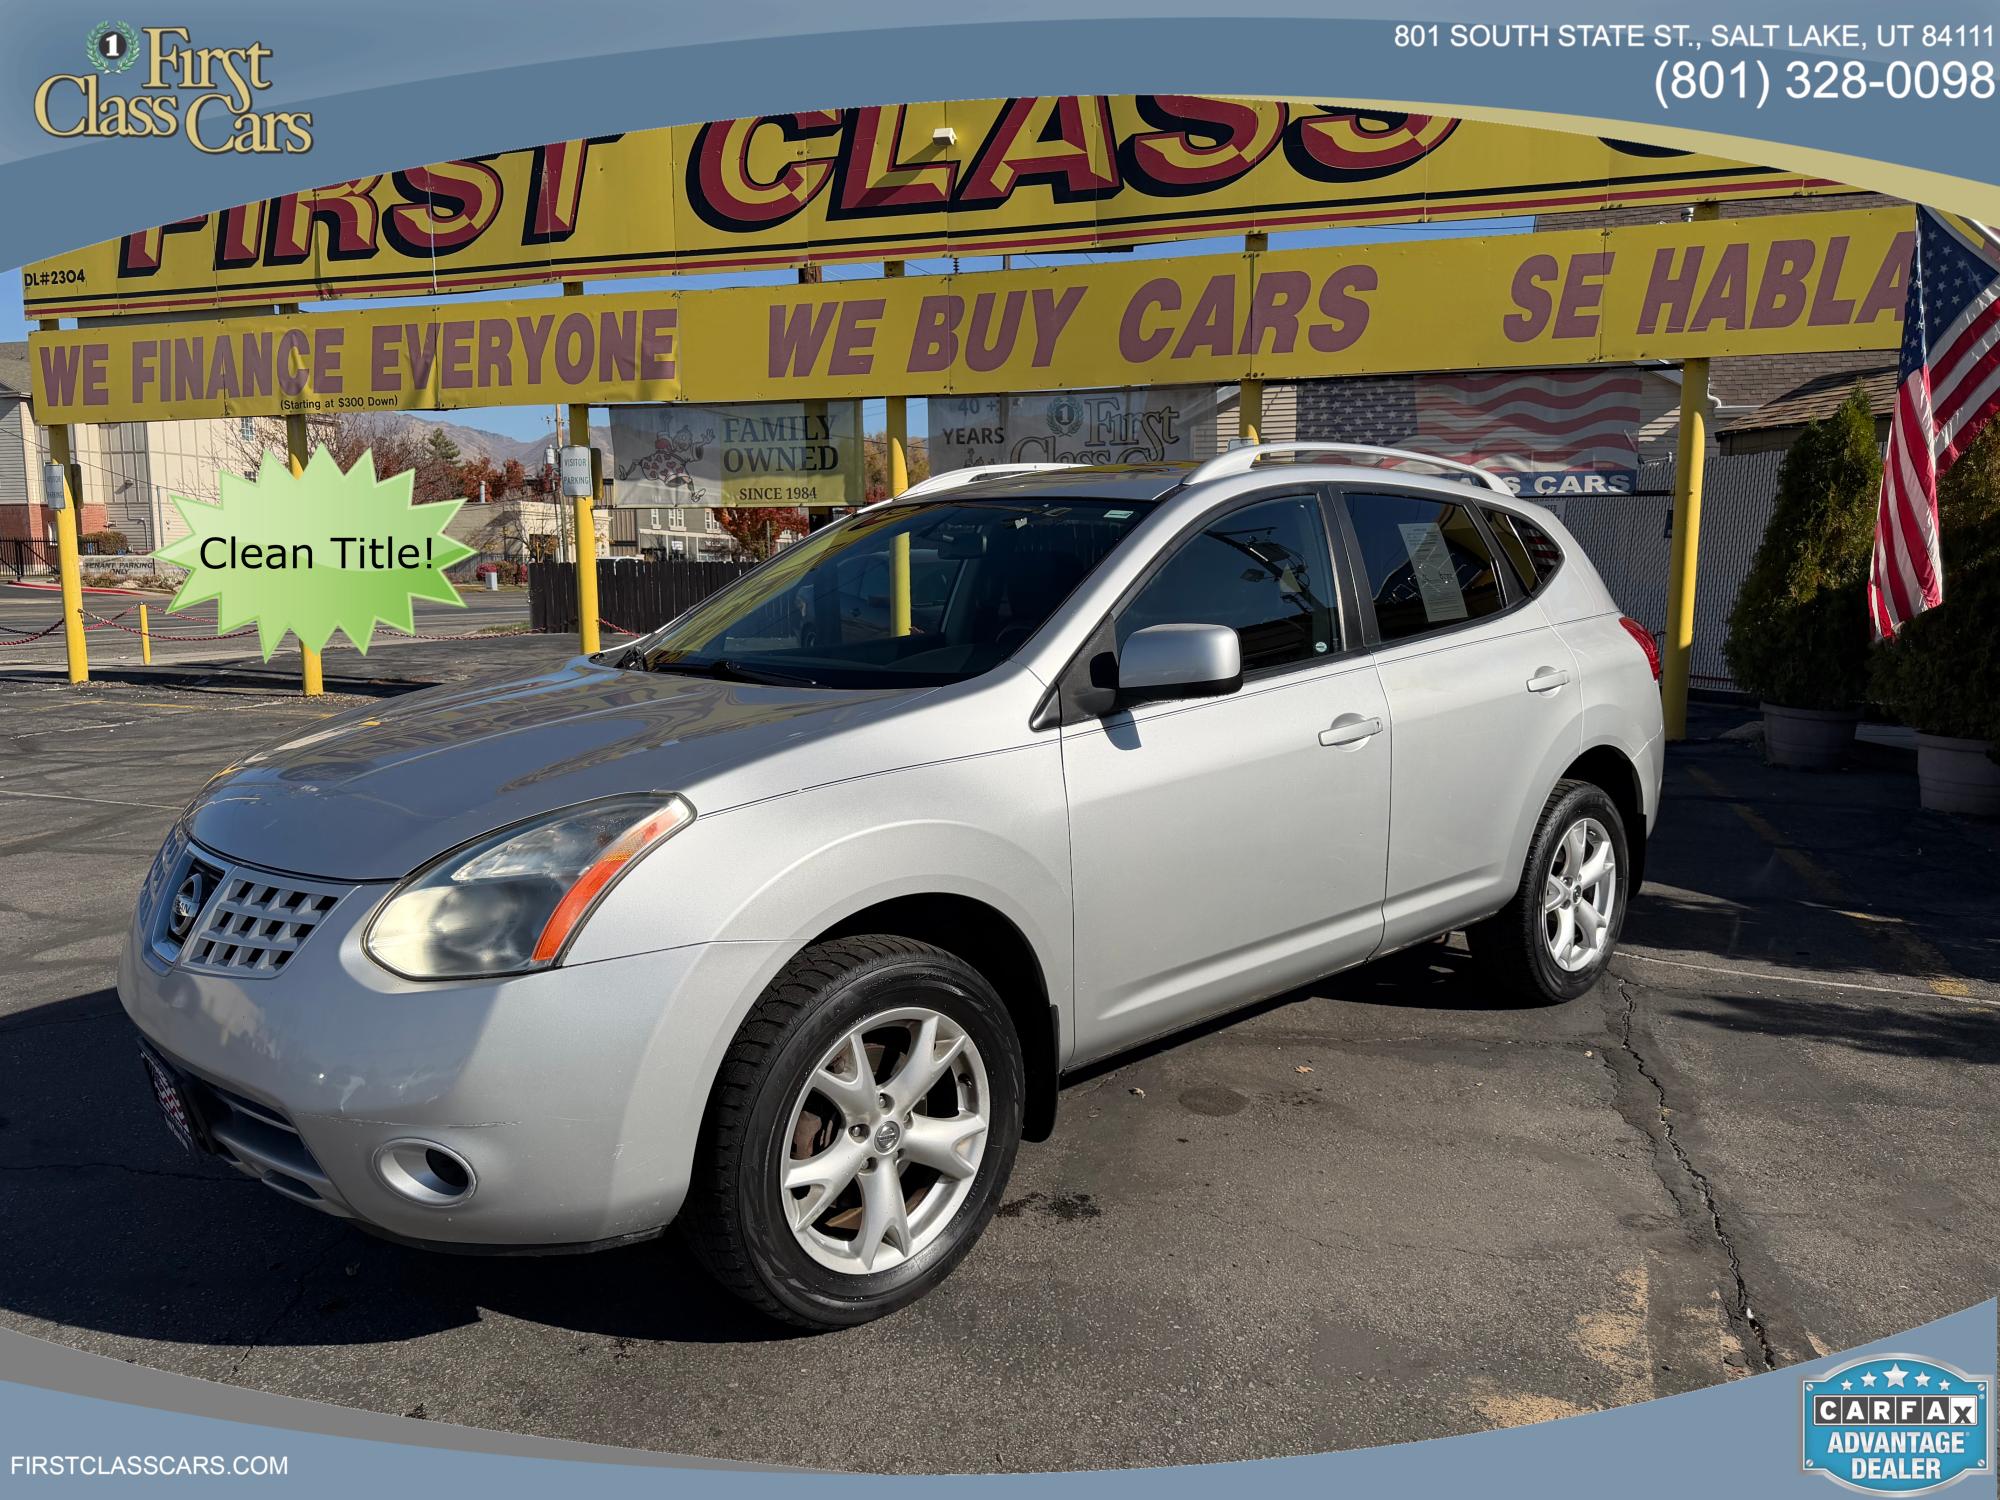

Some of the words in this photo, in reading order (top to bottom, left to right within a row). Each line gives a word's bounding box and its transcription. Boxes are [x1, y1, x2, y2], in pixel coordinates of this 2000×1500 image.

[686, 95, 1462, 233] CLASS
[24, 268, 86, 287] DL#2304
[1503, 251, 1616, 343] SE
[768, 298, 887, 378] WE
[906, 286, 1088, 373] BUY
[1118, 264, 1378, 364] CARS
[39, 343, 109, 407] WE
[132, 328, 344, 404] FINANCE
[371, 308, 678, 392] EVERYONE
[280, 400, 321, 411] (Starting
[324, 399, 334, 408] at
[368, 395, 398, 407] Down)
[958, 399, 980, 416] 40
[723, 414, 840, 443] FAMILY
[942, 427, 1005, 445] YEARS
[1084, 398, 1181, 463] First
[723, 446, 839, 472] OWNED
[739, 487, 782, 500] SINCE
[787, 486, 817, 499] 1984
[1534, 475, 1630, 494] CARS
